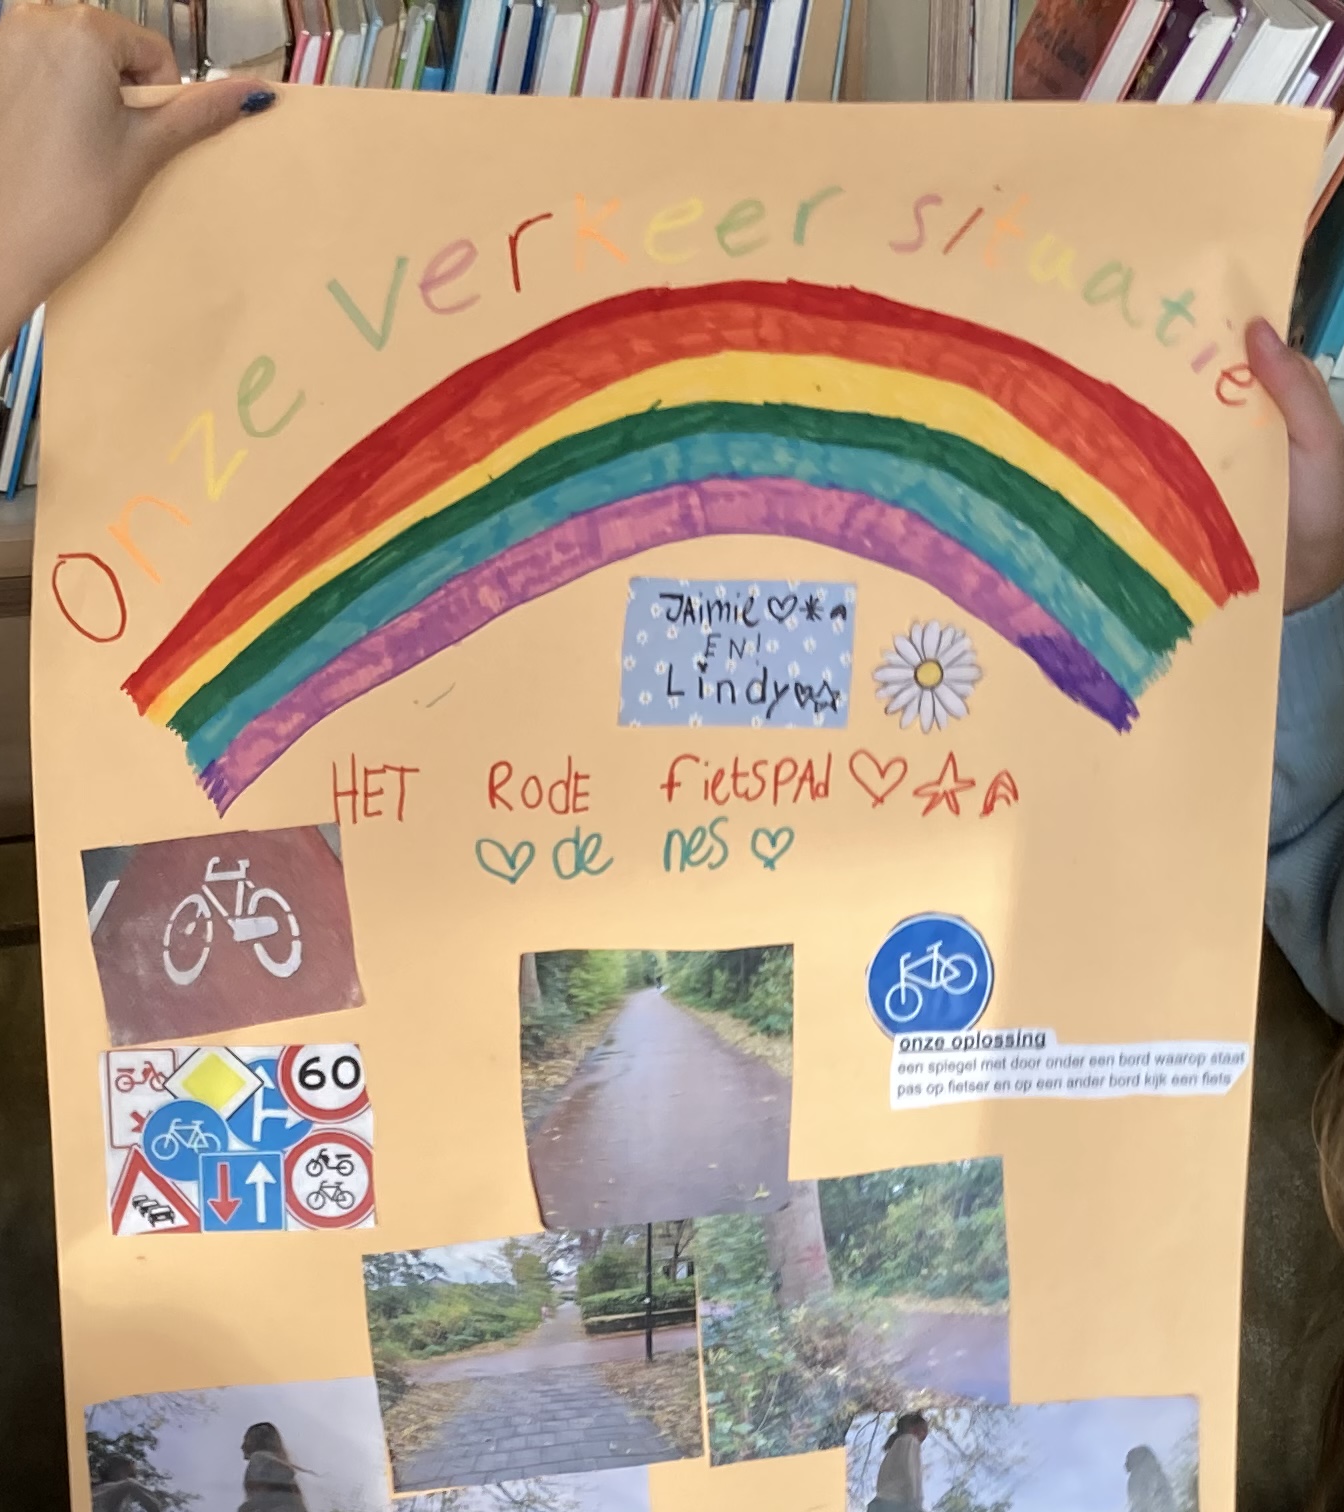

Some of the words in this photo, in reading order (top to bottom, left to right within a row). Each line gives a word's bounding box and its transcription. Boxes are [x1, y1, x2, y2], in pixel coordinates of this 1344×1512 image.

[666, 660, 790, 720] Lindy
[332, 752, 420, 826] HET
[552, 825, 614, 881] de
[898, 1035, 946, 1053] onze
[951, 1028, 1047, 1052] oplossing
[298, 1054, 362, 1091] 60
[897, 1062, 924, 1075] een
[927, 1058, 977, 1076] spiegel
[980, 1058, 1006, 1072] met
[1010, 1055, 1042, 1070] door
[1045, 1053, 1086, 1069] onder
[1089, 1054, 1115, 1067] een
[1118, 1051, 1151, 1067] bord
[1155, 1052, 1207, 1068] waarop
[1210, 1050, 1246, 1065] staat
[897, 1083, 922, 1099] pas
[926, 1083, 944, 1098] op
[948, 1079, 991, 1094] fietser
[993, 1080, 1011, 1092] en
[1014, 1079, 1032, 1093] op
[1036, 1077, 1062, 1089] een
[1066, 1074, 1105, 1089] ander
[1108, 1072, 1141, 1087] bord
[1143, 1072, 1168, 1090] kijk
[1171, 1074, 1198, 1087] een
[1202, 1071, 1232, 1086] fiets
